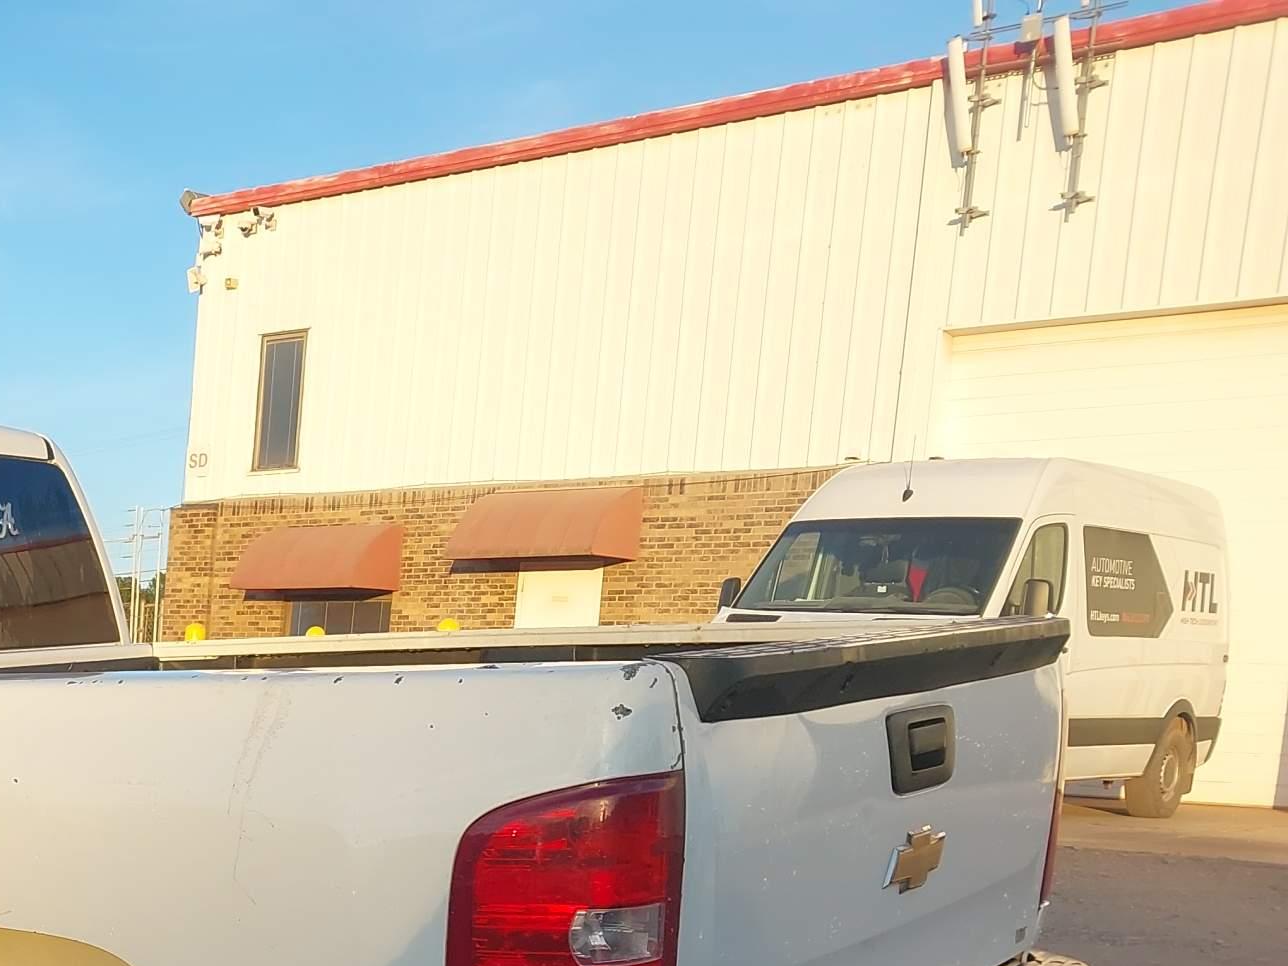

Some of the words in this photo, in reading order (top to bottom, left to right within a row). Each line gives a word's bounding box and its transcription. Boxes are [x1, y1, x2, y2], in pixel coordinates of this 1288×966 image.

[189, 453, 208, 469] SD
[1091, 556, 1133, 576] AUTOMOTIVE
[1091, 575, 1103, 587] KEY
[1103, 576, 1136, 590] SPECIALISTS
[1180, 569, 1218, 614] HTL
